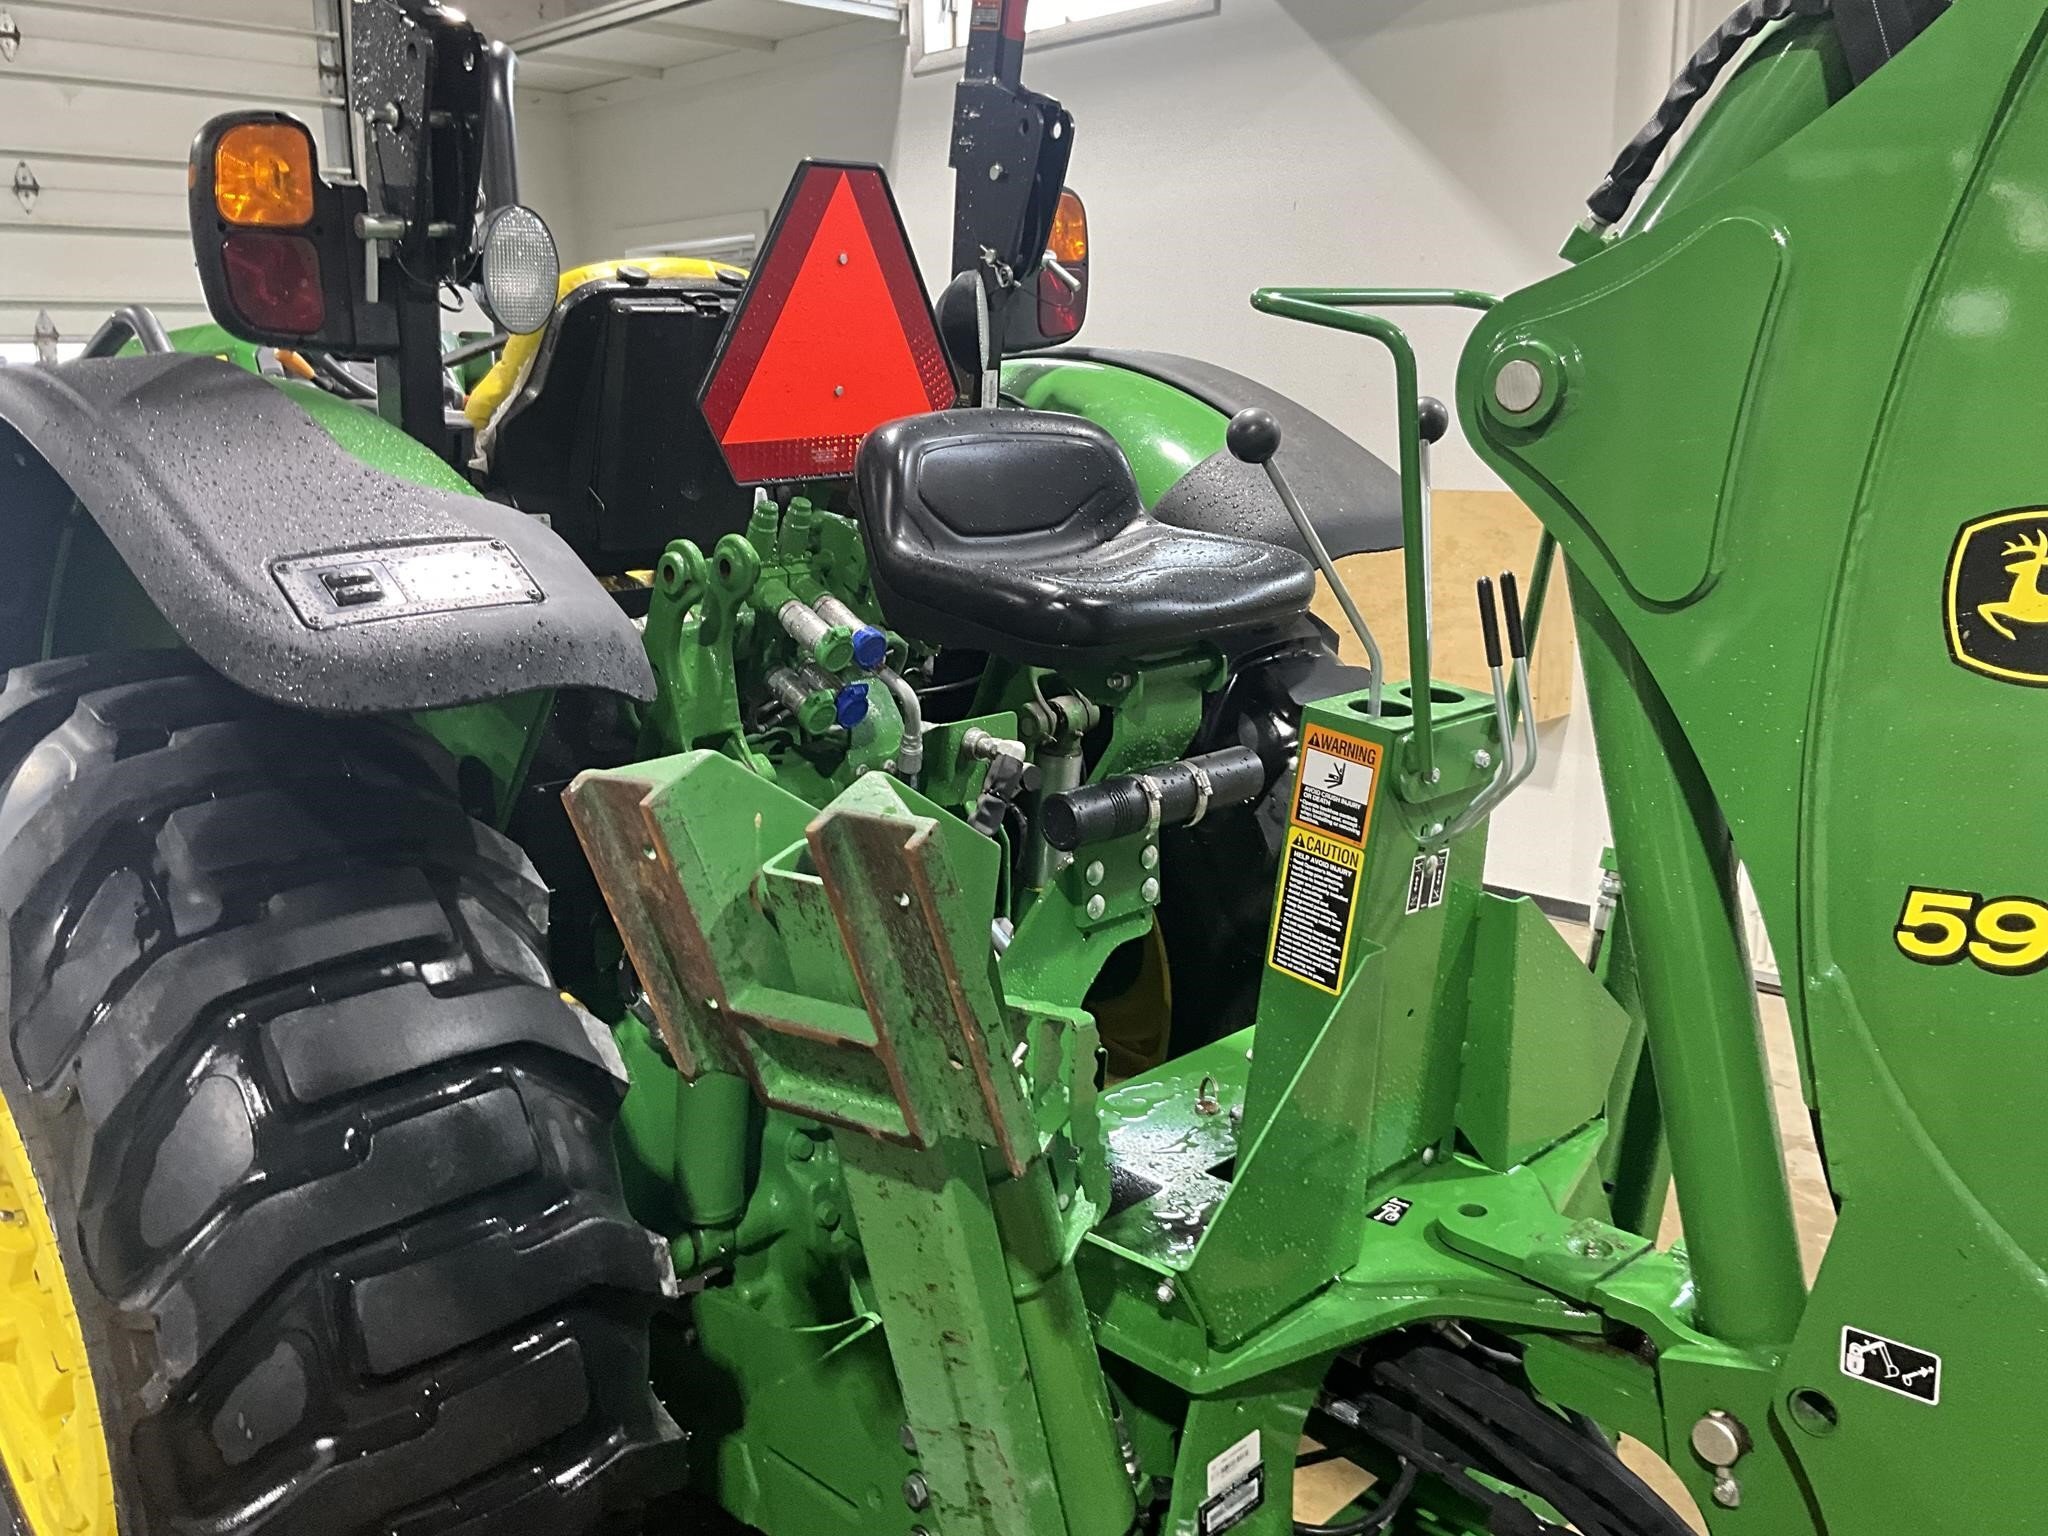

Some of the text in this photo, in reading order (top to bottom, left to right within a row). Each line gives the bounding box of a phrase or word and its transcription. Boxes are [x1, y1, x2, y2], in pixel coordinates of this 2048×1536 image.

[1321, 733, 1377, 765] WARNING
[1293, 850, 1353, 878] HELP AVOID INJURY
[1306, 836, 1359, 868] CAUTION
